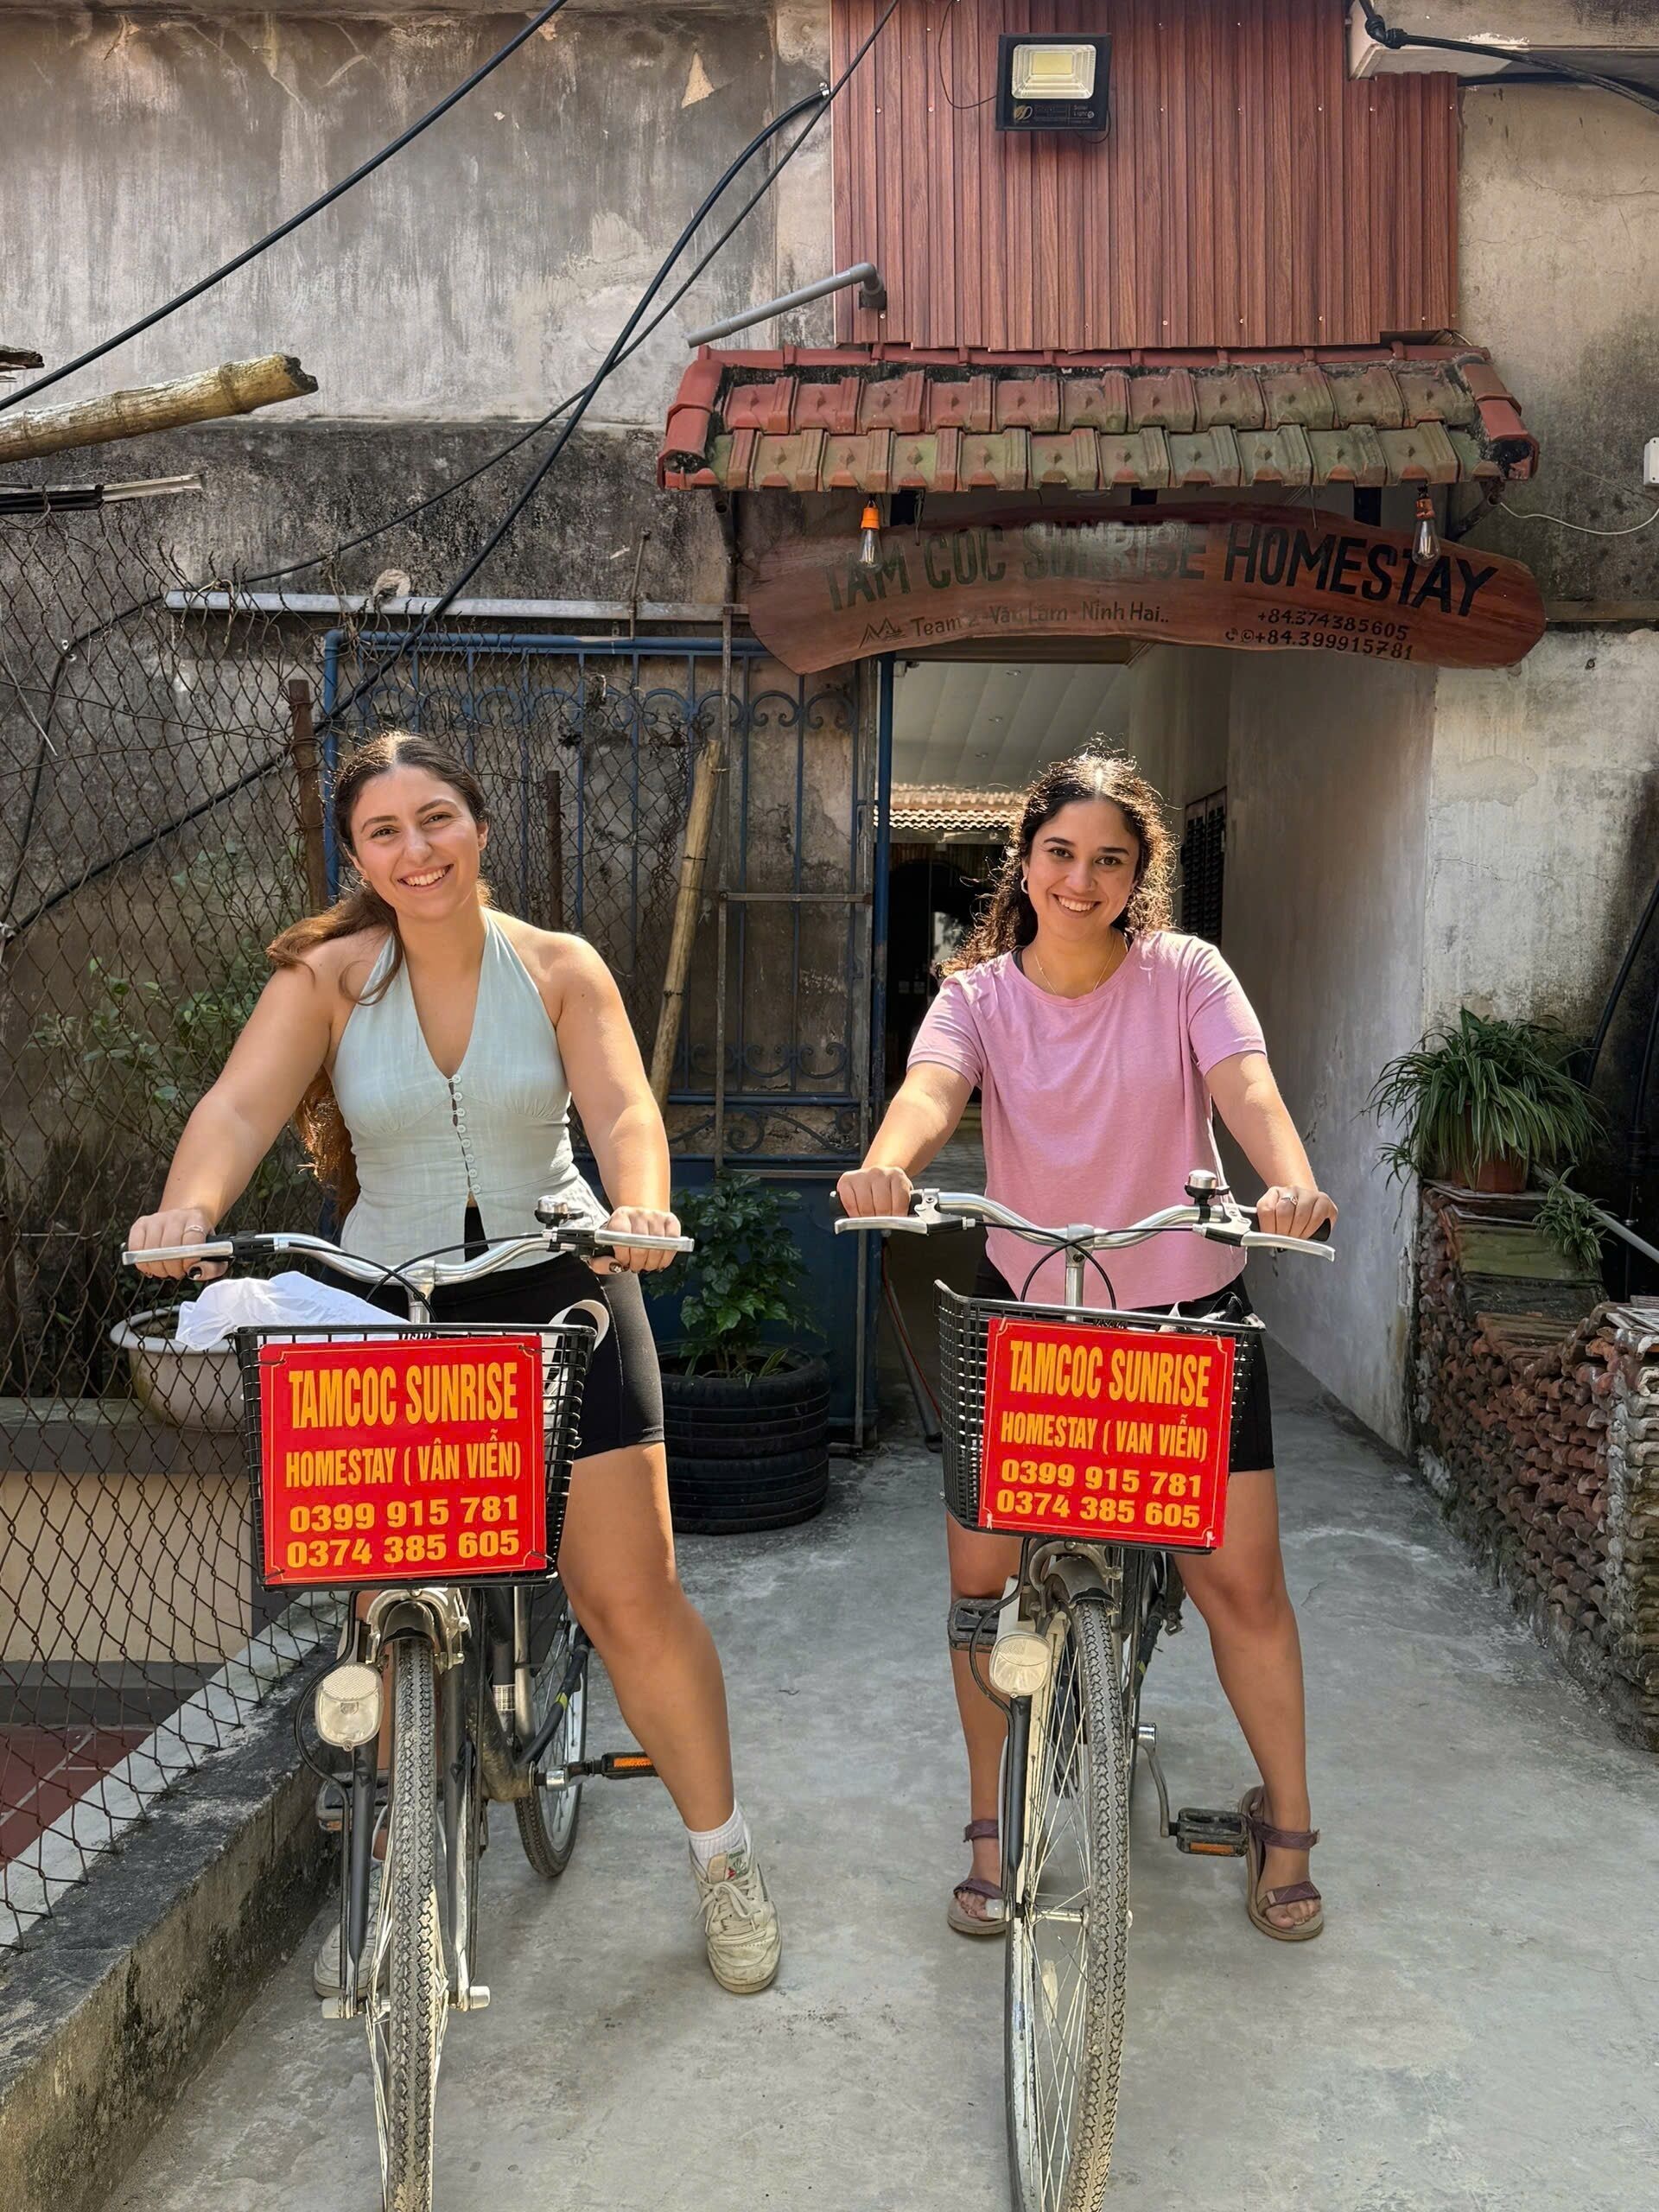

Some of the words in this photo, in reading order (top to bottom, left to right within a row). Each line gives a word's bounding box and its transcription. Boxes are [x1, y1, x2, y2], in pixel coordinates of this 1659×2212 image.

[1224, 523, 1498, 617] HOMESTAY
[910, 616, 963, 637] Team
[1082, 600, 1124, 620] Ninh
[1009, 1340, 1103, 1399] TAMCOC
[1109, 1348, 1211, 1408] SUNRISE
[289, 1365, 397, 1429] TAMCOC
[405, 1362, 518, 1424] SUNRISE
[1001, 1410, 1098, 1451] HOMESTAY
[286, 1446, 397, 1488] HOMESTAY
[417, 1437, 461, 1482] VÂN
[1001, 1459, 1075, 1488] 0399
[1084, 1465, 1140, 1494] 915
[1149, 1471, 1201, 1498] 781
[289, 1502, 375, 1533] 0399
[386, 1498, 449, 1528] 915
[460, 1495, 518, 1523] 781
[996, 1489, 1071, 1518] 0374
[1079, 1497, 1135, 1524] 385
[1145, 1502, 1200, 1529] 605
[287, 1538, 372, 1568] 0374
[384, 1534, 447, 1564] 385
[458, 1529, 519, 1559] 605
